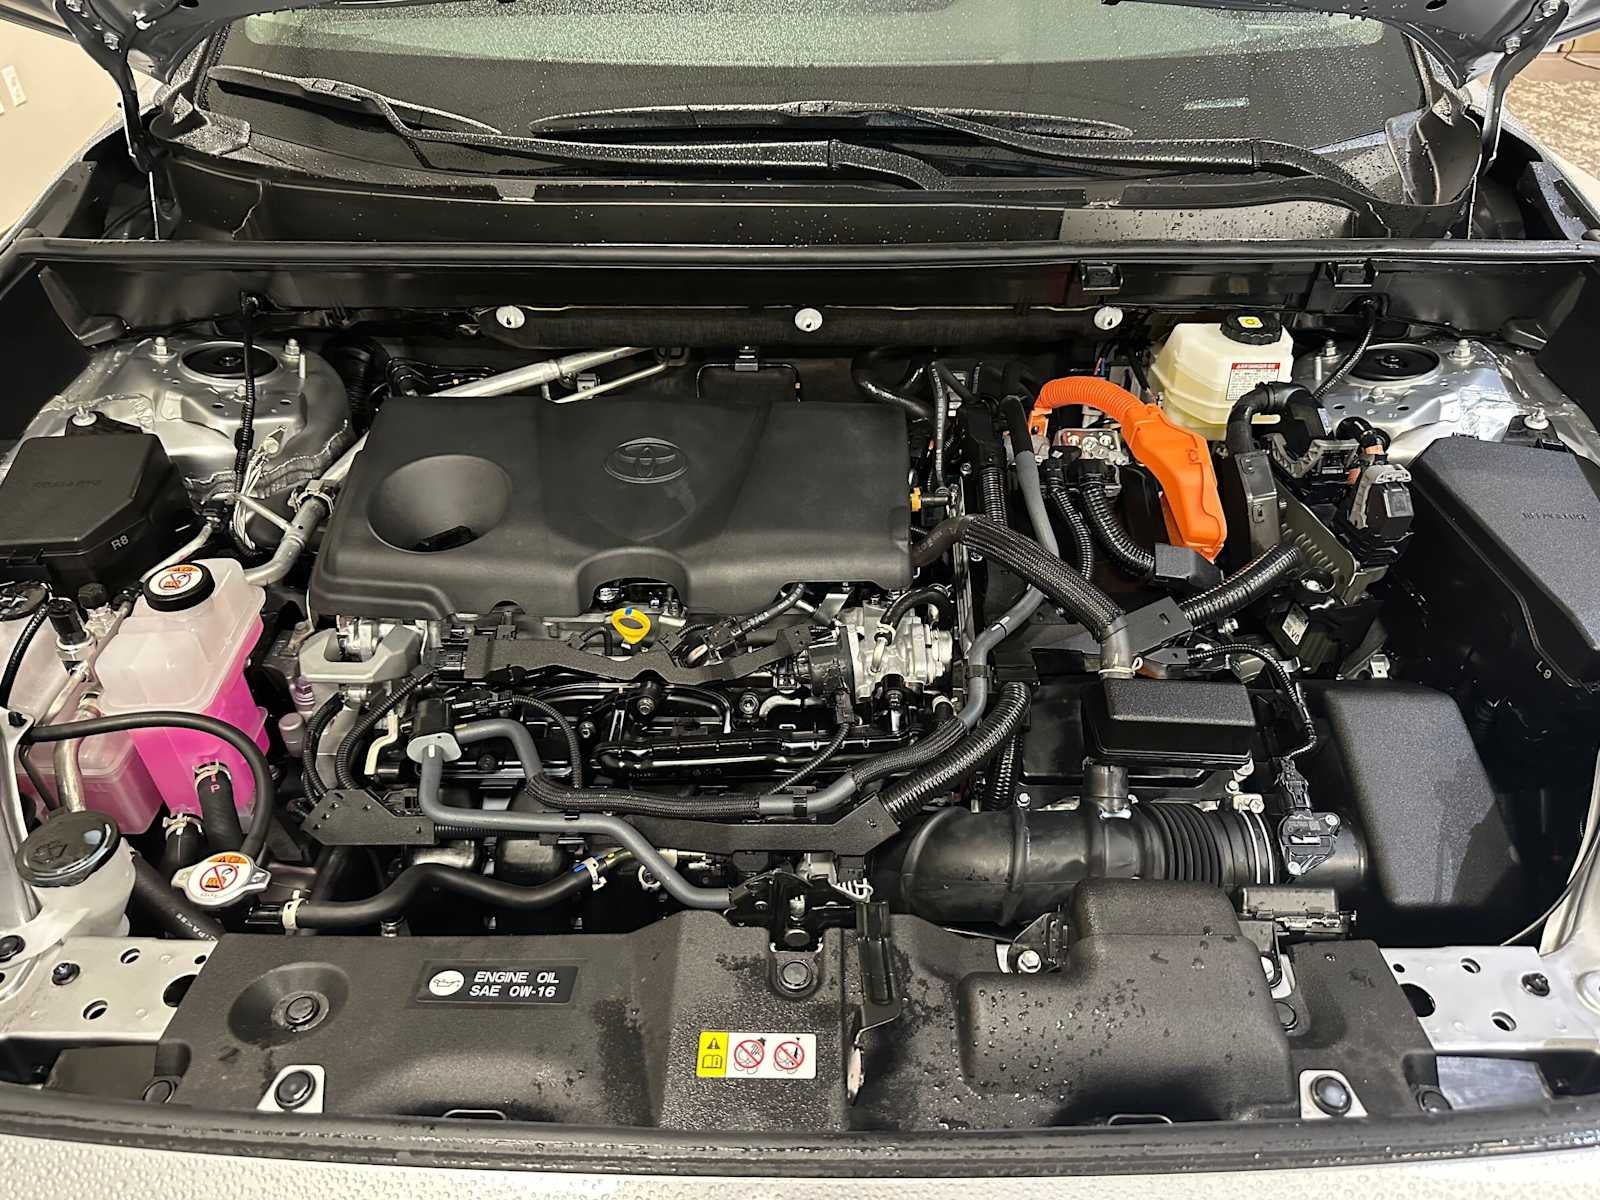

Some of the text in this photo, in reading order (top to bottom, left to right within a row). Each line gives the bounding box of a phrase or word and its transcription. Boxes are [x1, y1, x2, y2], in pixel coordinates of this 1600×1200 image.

[111, 535, 129, 550] R8
[474, 971, 559, 984] ENGINE OIL
[469, 985, 556, 998] SAE 0W-16
